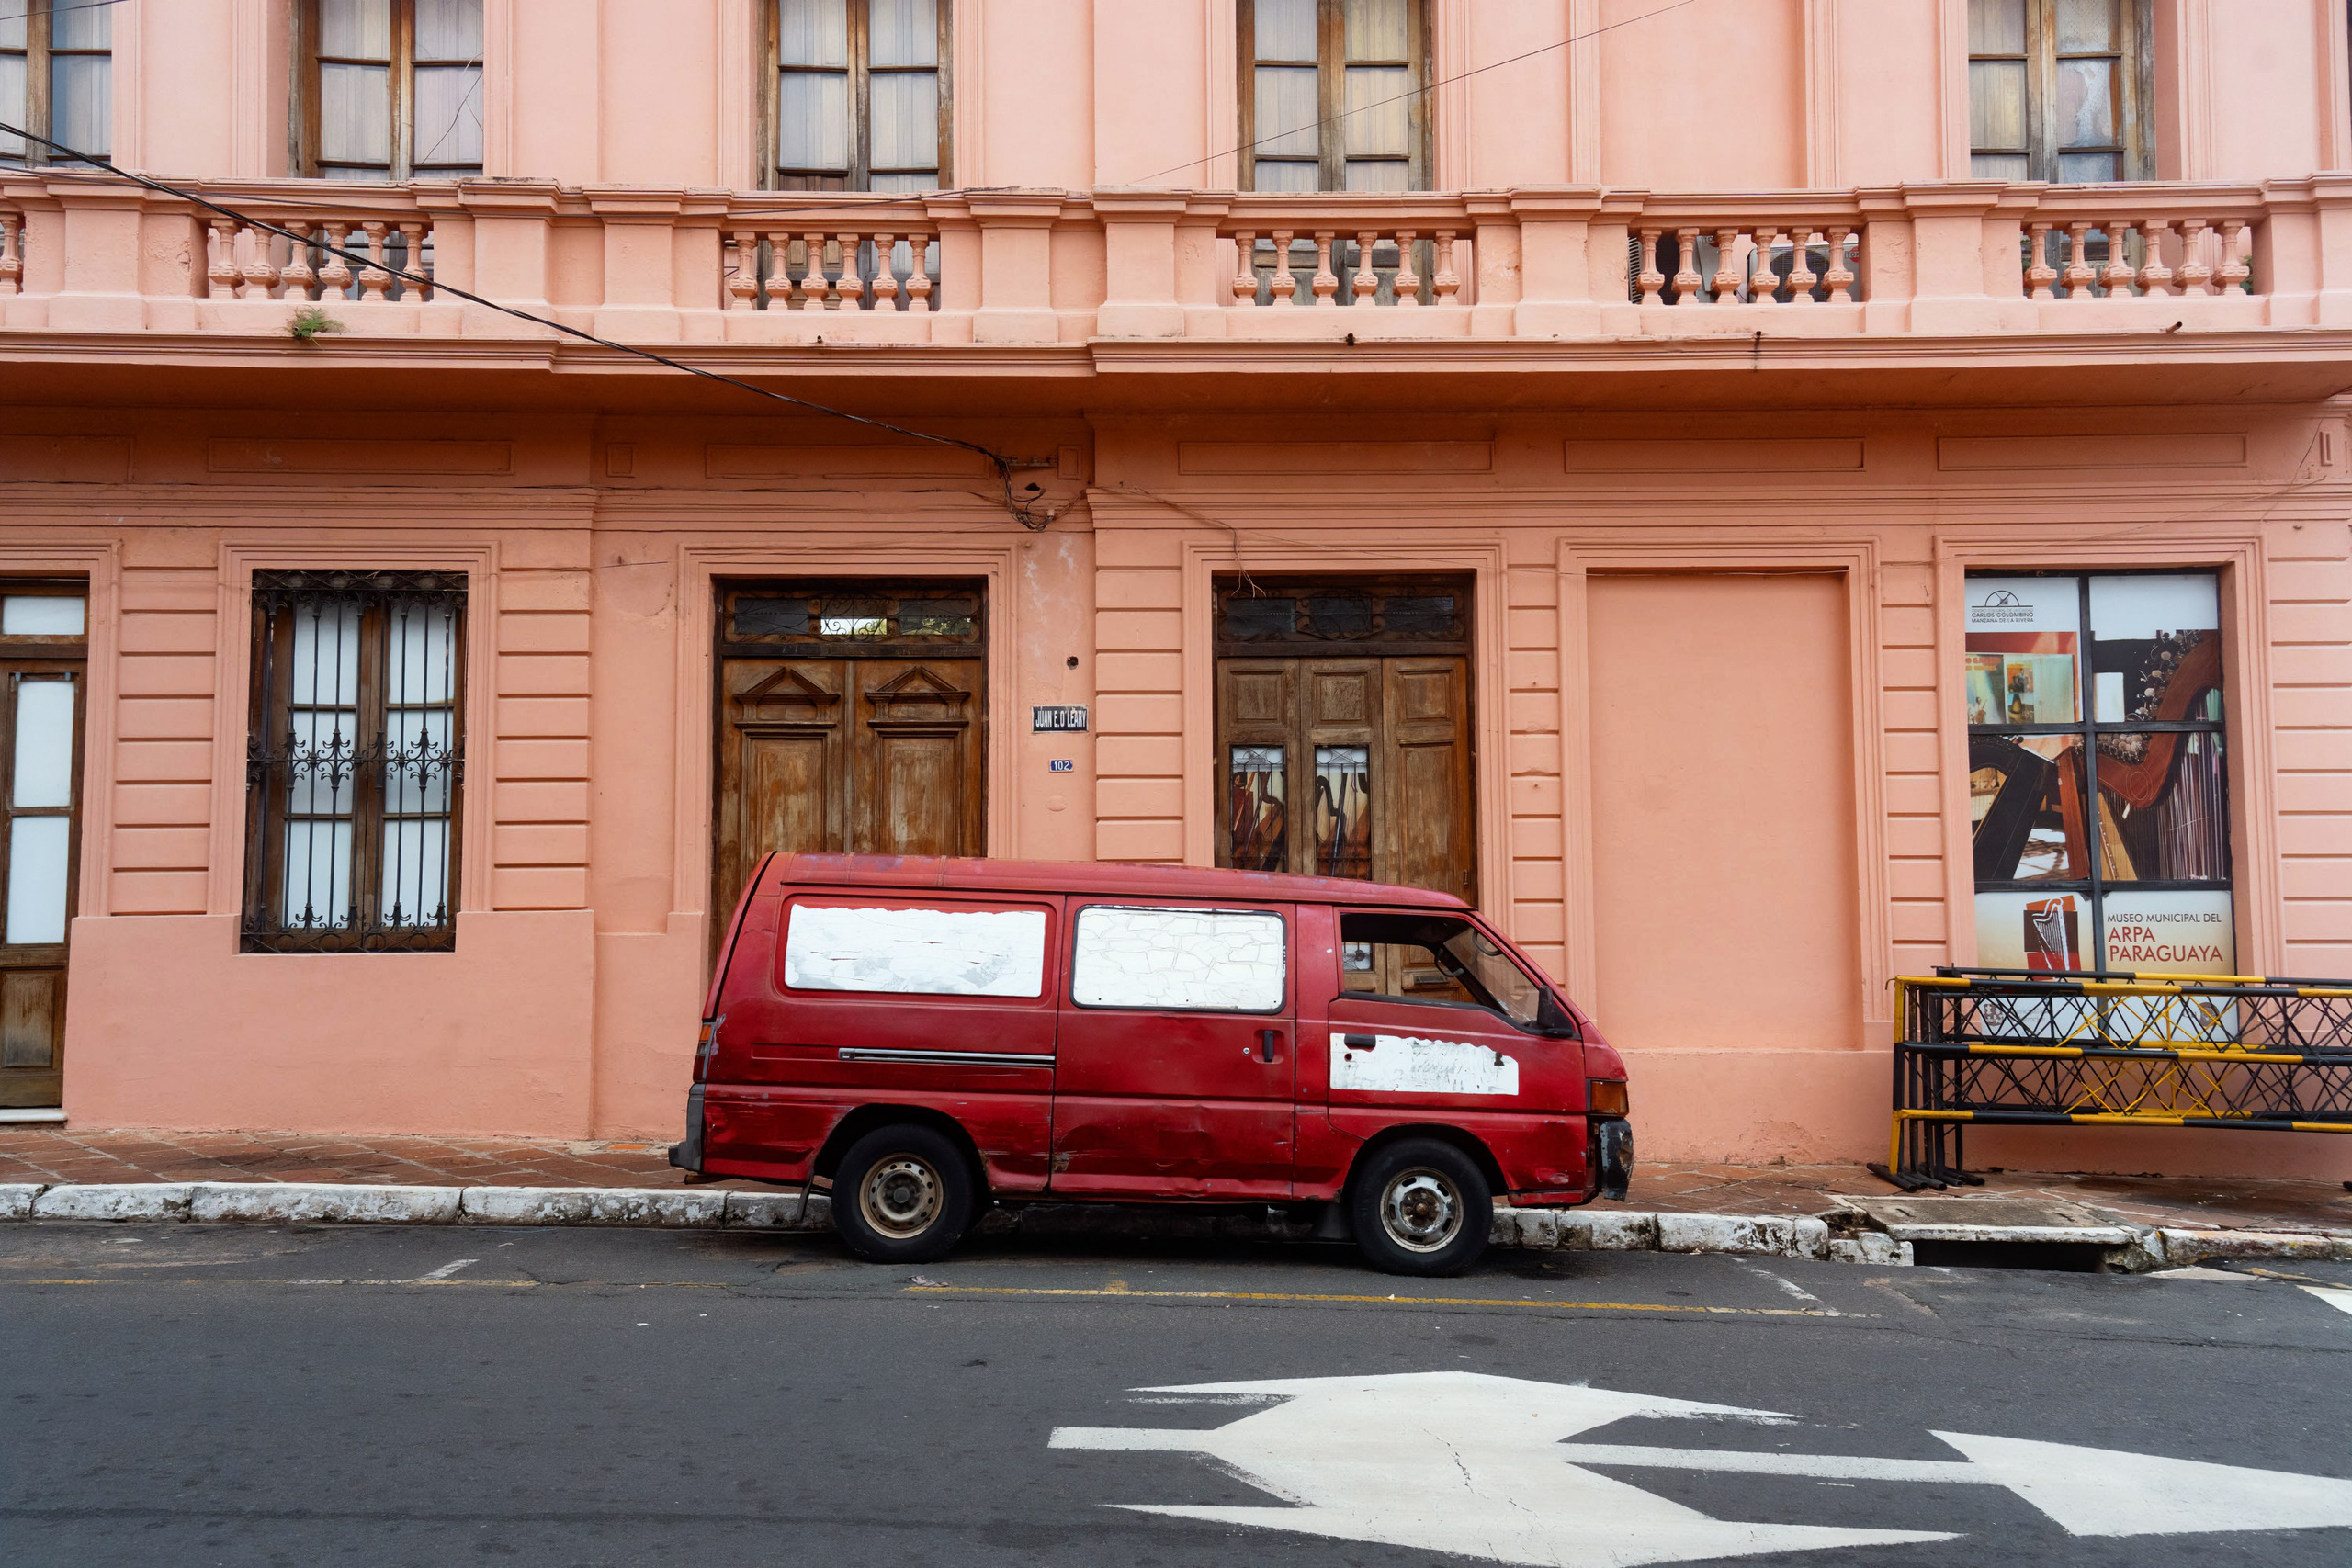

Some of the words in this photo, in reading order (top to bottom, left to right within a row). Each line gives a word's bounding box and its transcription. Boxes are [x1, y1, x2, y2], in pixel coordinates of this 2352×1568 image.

[1035, 710, 1052, 728] JUAN
[1054, 761, 1069, 771] 102
[2107, 914, 2143, 923] MUSEO
[2145, 914, 2200, 923] MUNICIPAL
[2203, 913, 2222, 923] DEL
[2108, 926, 2155, 942] ARPA
[2109, 944, 2224, 963] PARAGUAYA
